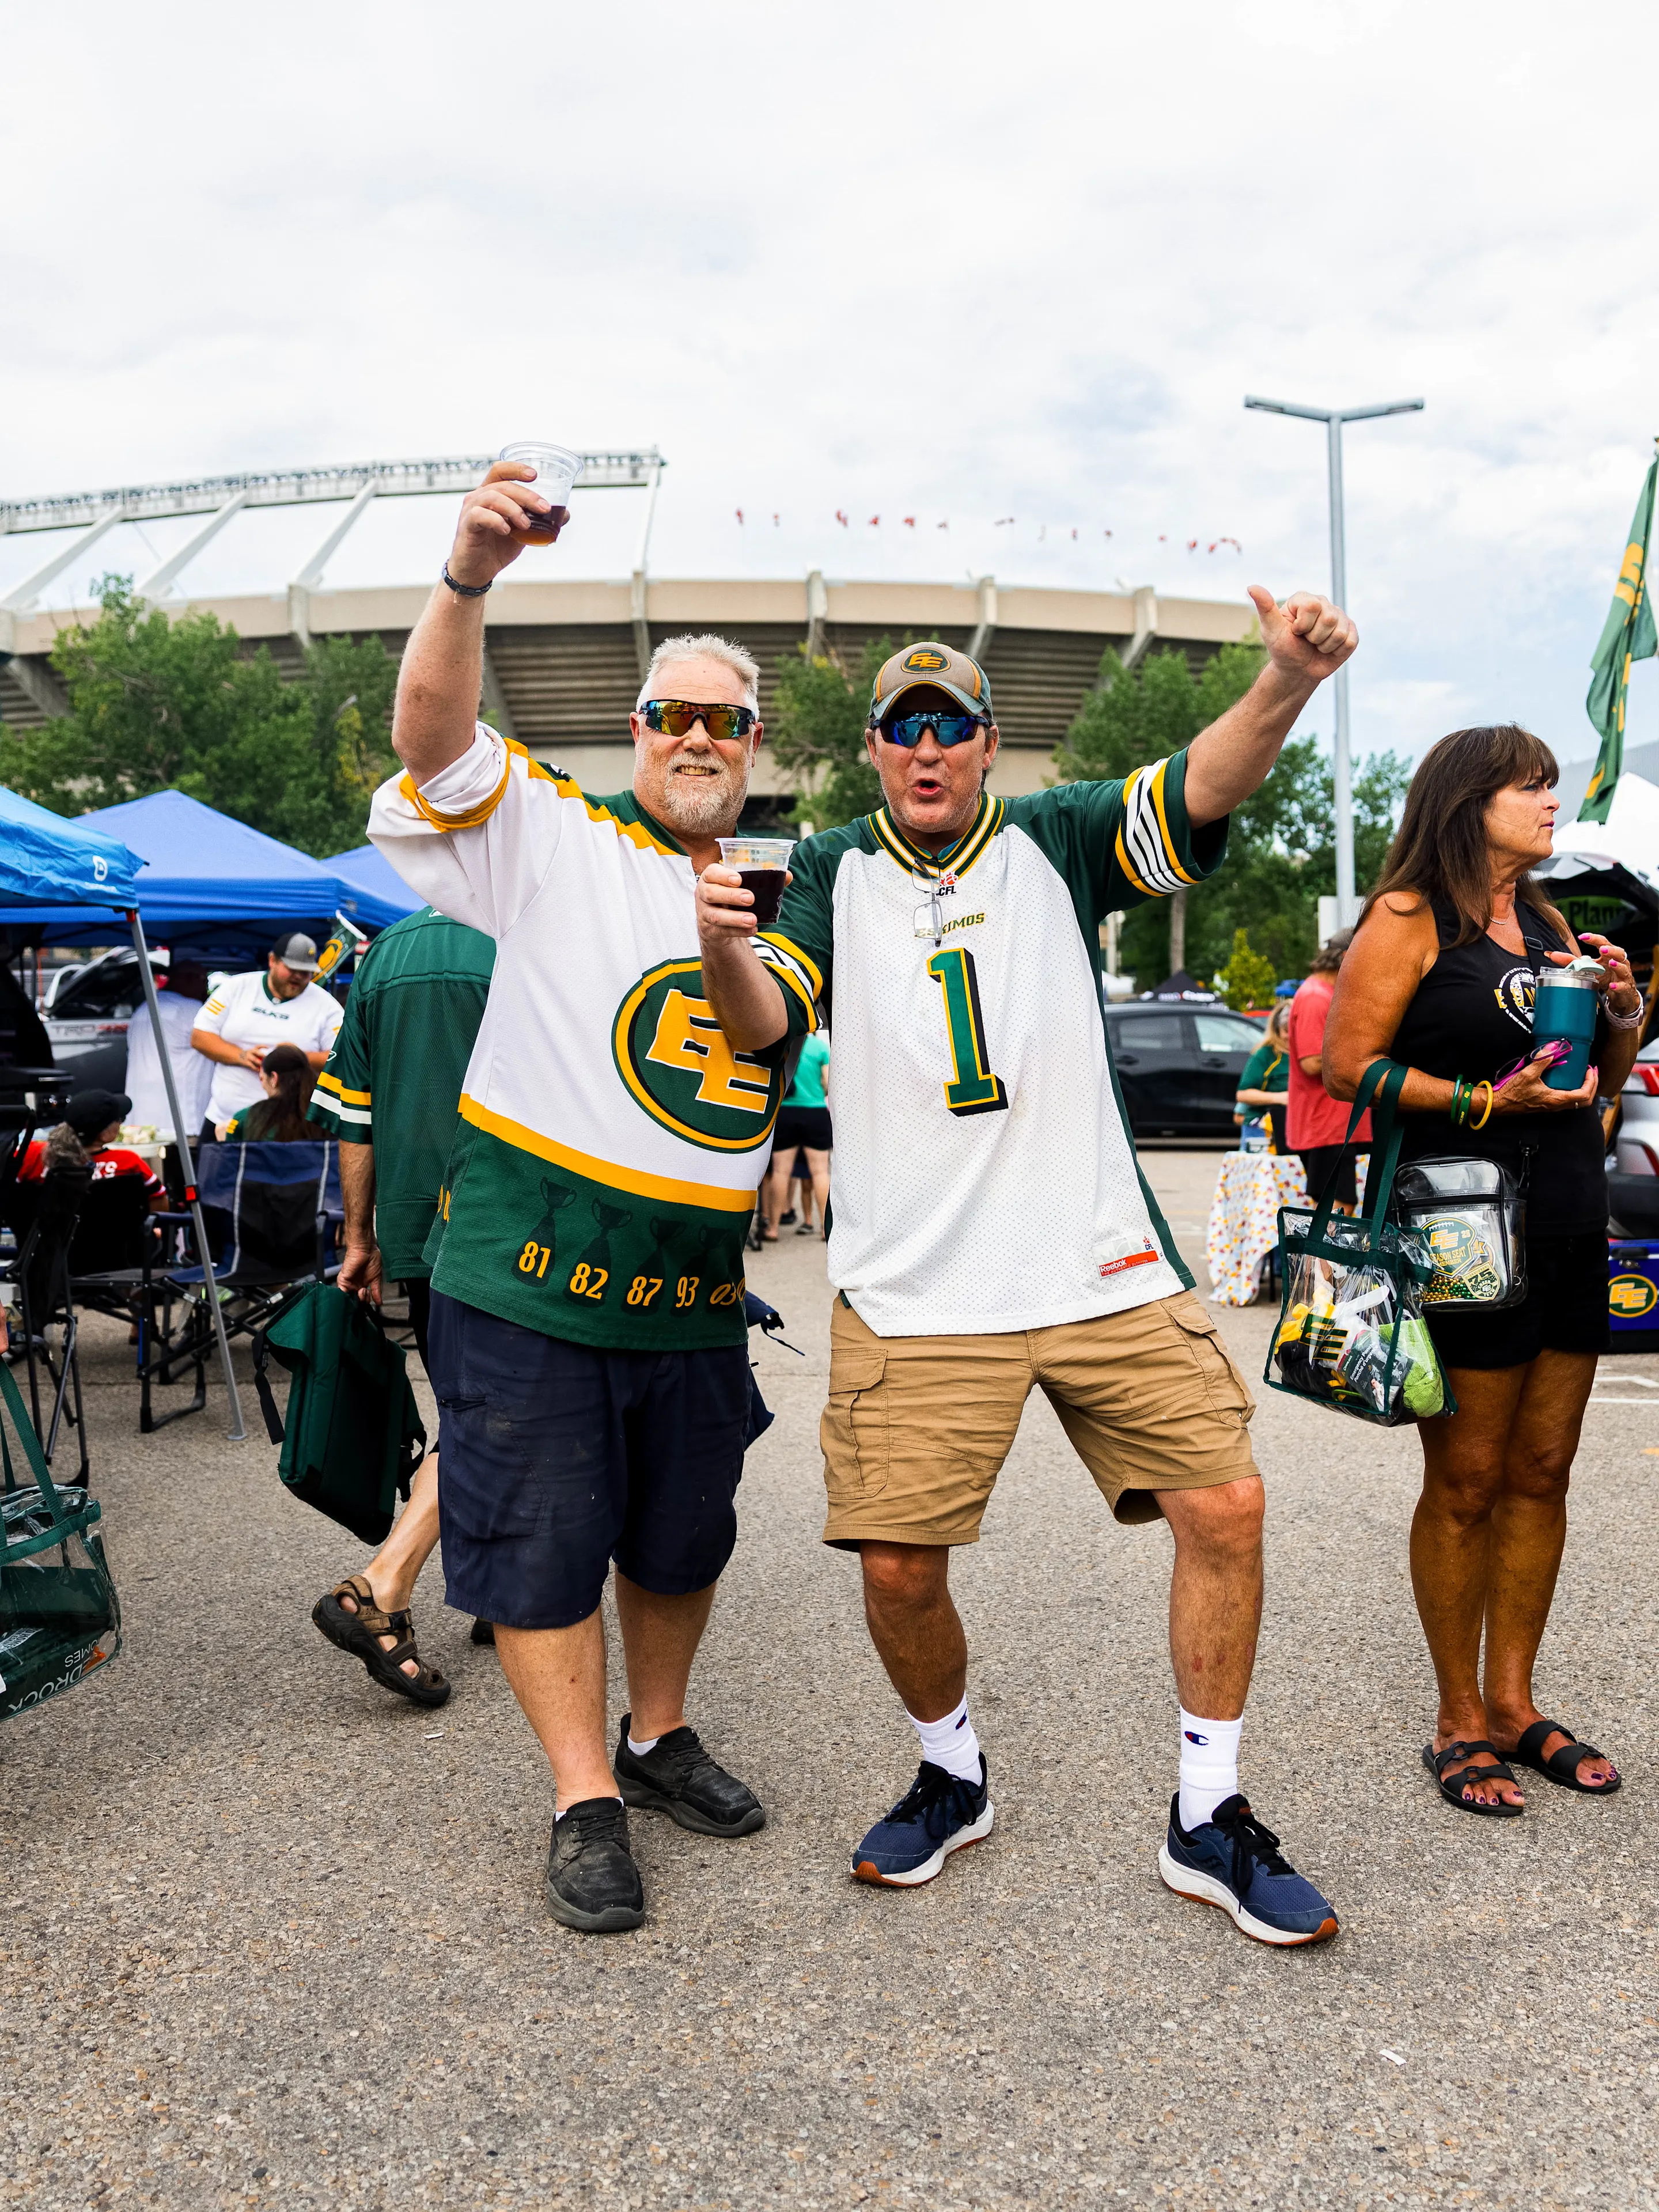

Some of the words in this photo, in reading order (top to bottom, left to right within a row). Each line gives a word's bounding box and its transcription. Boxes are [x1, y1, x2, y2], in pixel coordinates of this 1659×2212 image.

[938, 885, 957, 896] CFL
[252, 1007, 289, 1020] ELKS
[927, 948, 1008, 1117] 1
[1099, 1259, 1127, 1273] Reebok
[1430, 1251, 1452, 1263] SEASON
[1453, 1246, 1466, 1259] SEAT
[518, 1241, 551, 1279] 81
[569, 1262, 609, 1300] 82
[626, 1276, 664, 1306] 87
[675, 1276, 700, 1308] 93
[1468, 1268, 1493, 1285] 75
[1349, 1355, 1365, 1381] Emergency
[1361, 1342, 1377, 1358] Ponch
[1353, 1365, 1365, 1383] Poncho
[1362, 1346, 1378, 1368] d'urgenc
[65, 1639, 98, 1668] OMES
